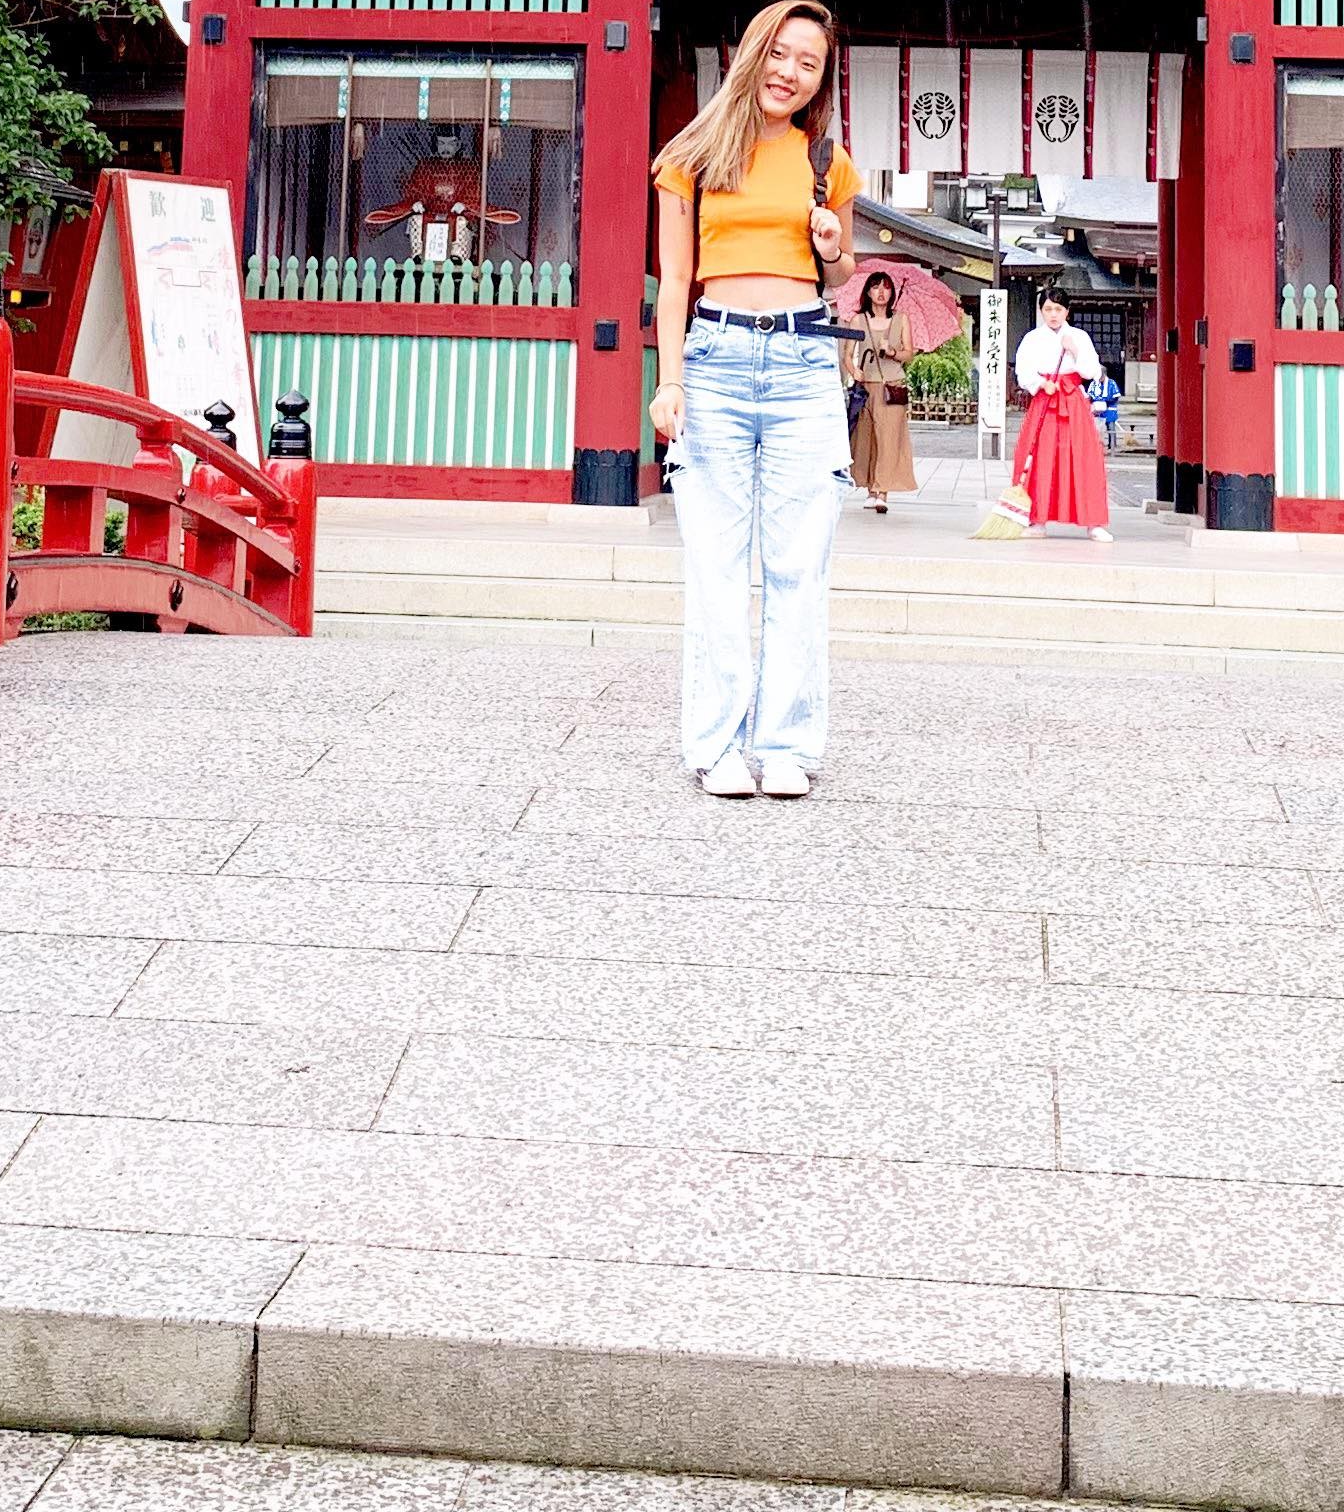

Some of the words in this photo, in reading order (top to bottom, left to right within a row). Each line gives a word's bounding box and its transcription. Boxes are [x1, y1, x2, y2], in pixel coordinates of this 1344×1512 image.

[986, 294, 1003, 374] 御朱印受付
